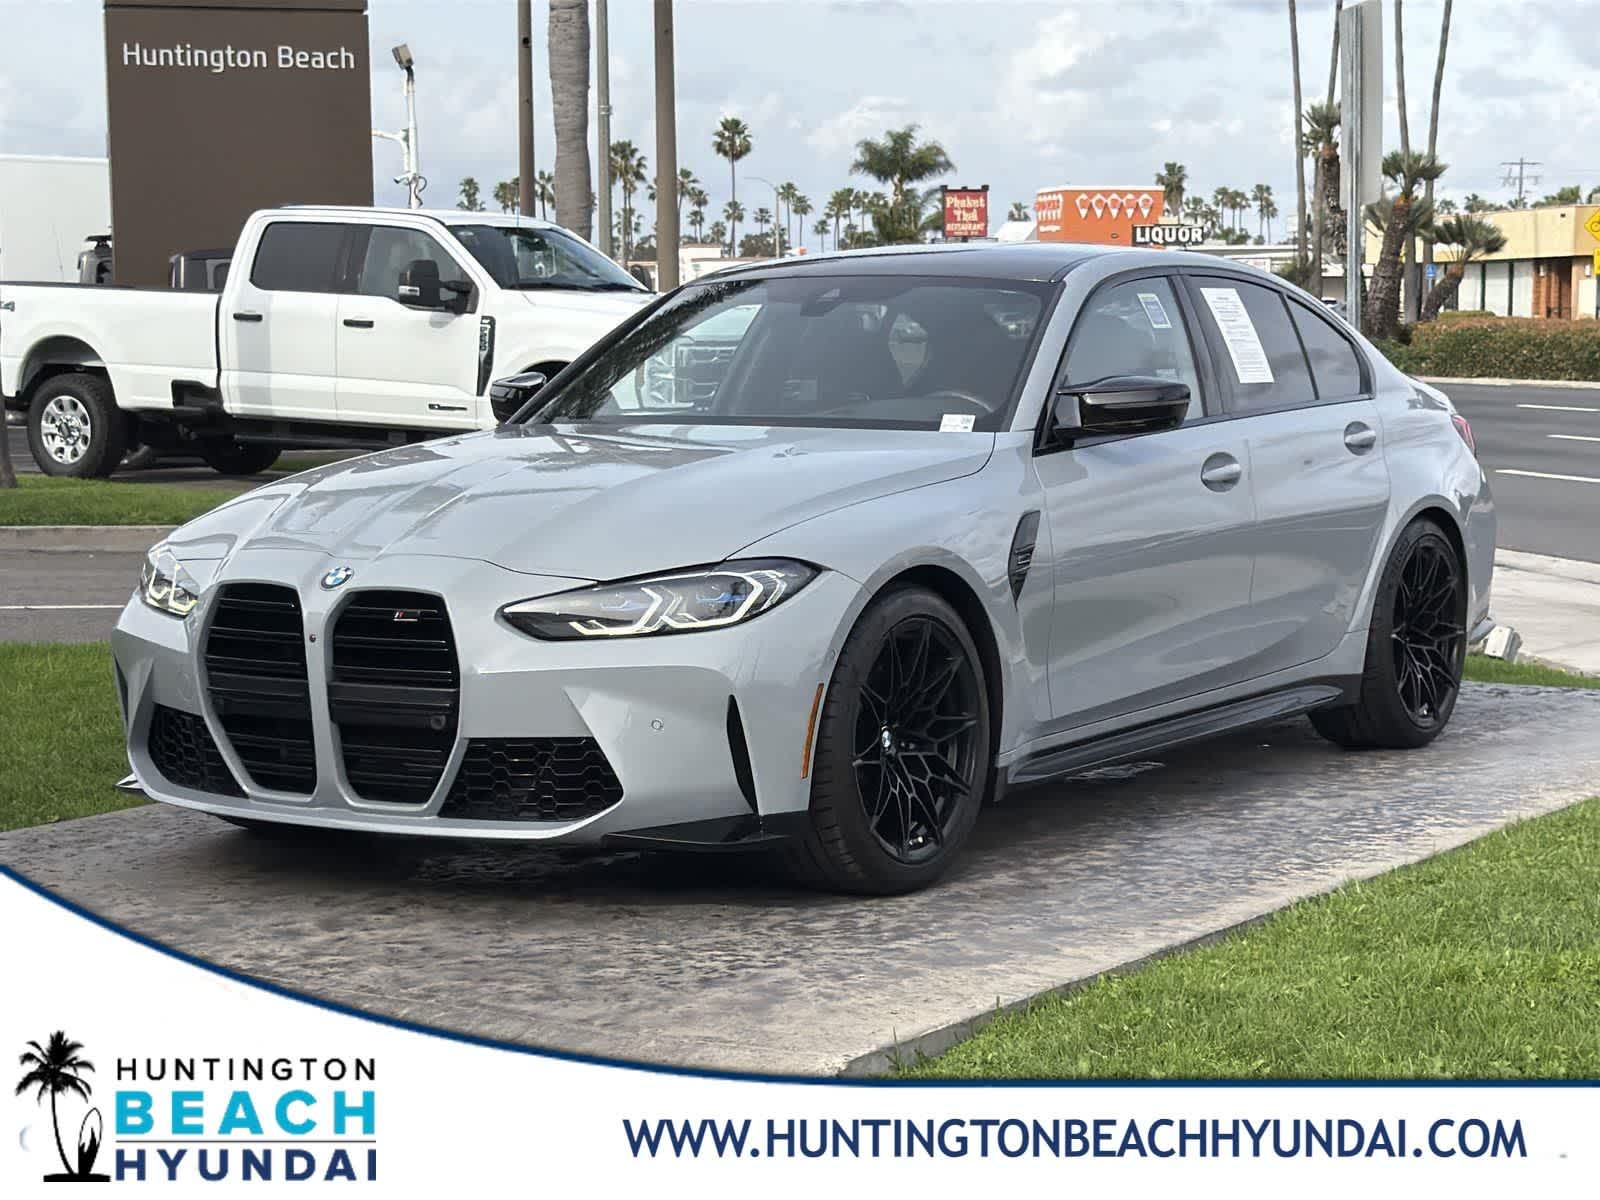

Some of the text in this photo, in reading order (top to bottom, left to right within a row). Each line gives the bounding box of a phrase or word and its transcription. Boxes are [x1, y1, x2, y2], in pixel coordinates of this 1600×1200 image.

[123, 42, 355, 73] Huntington Beach
[1135, 226, 1203, 244] LIQUOR
